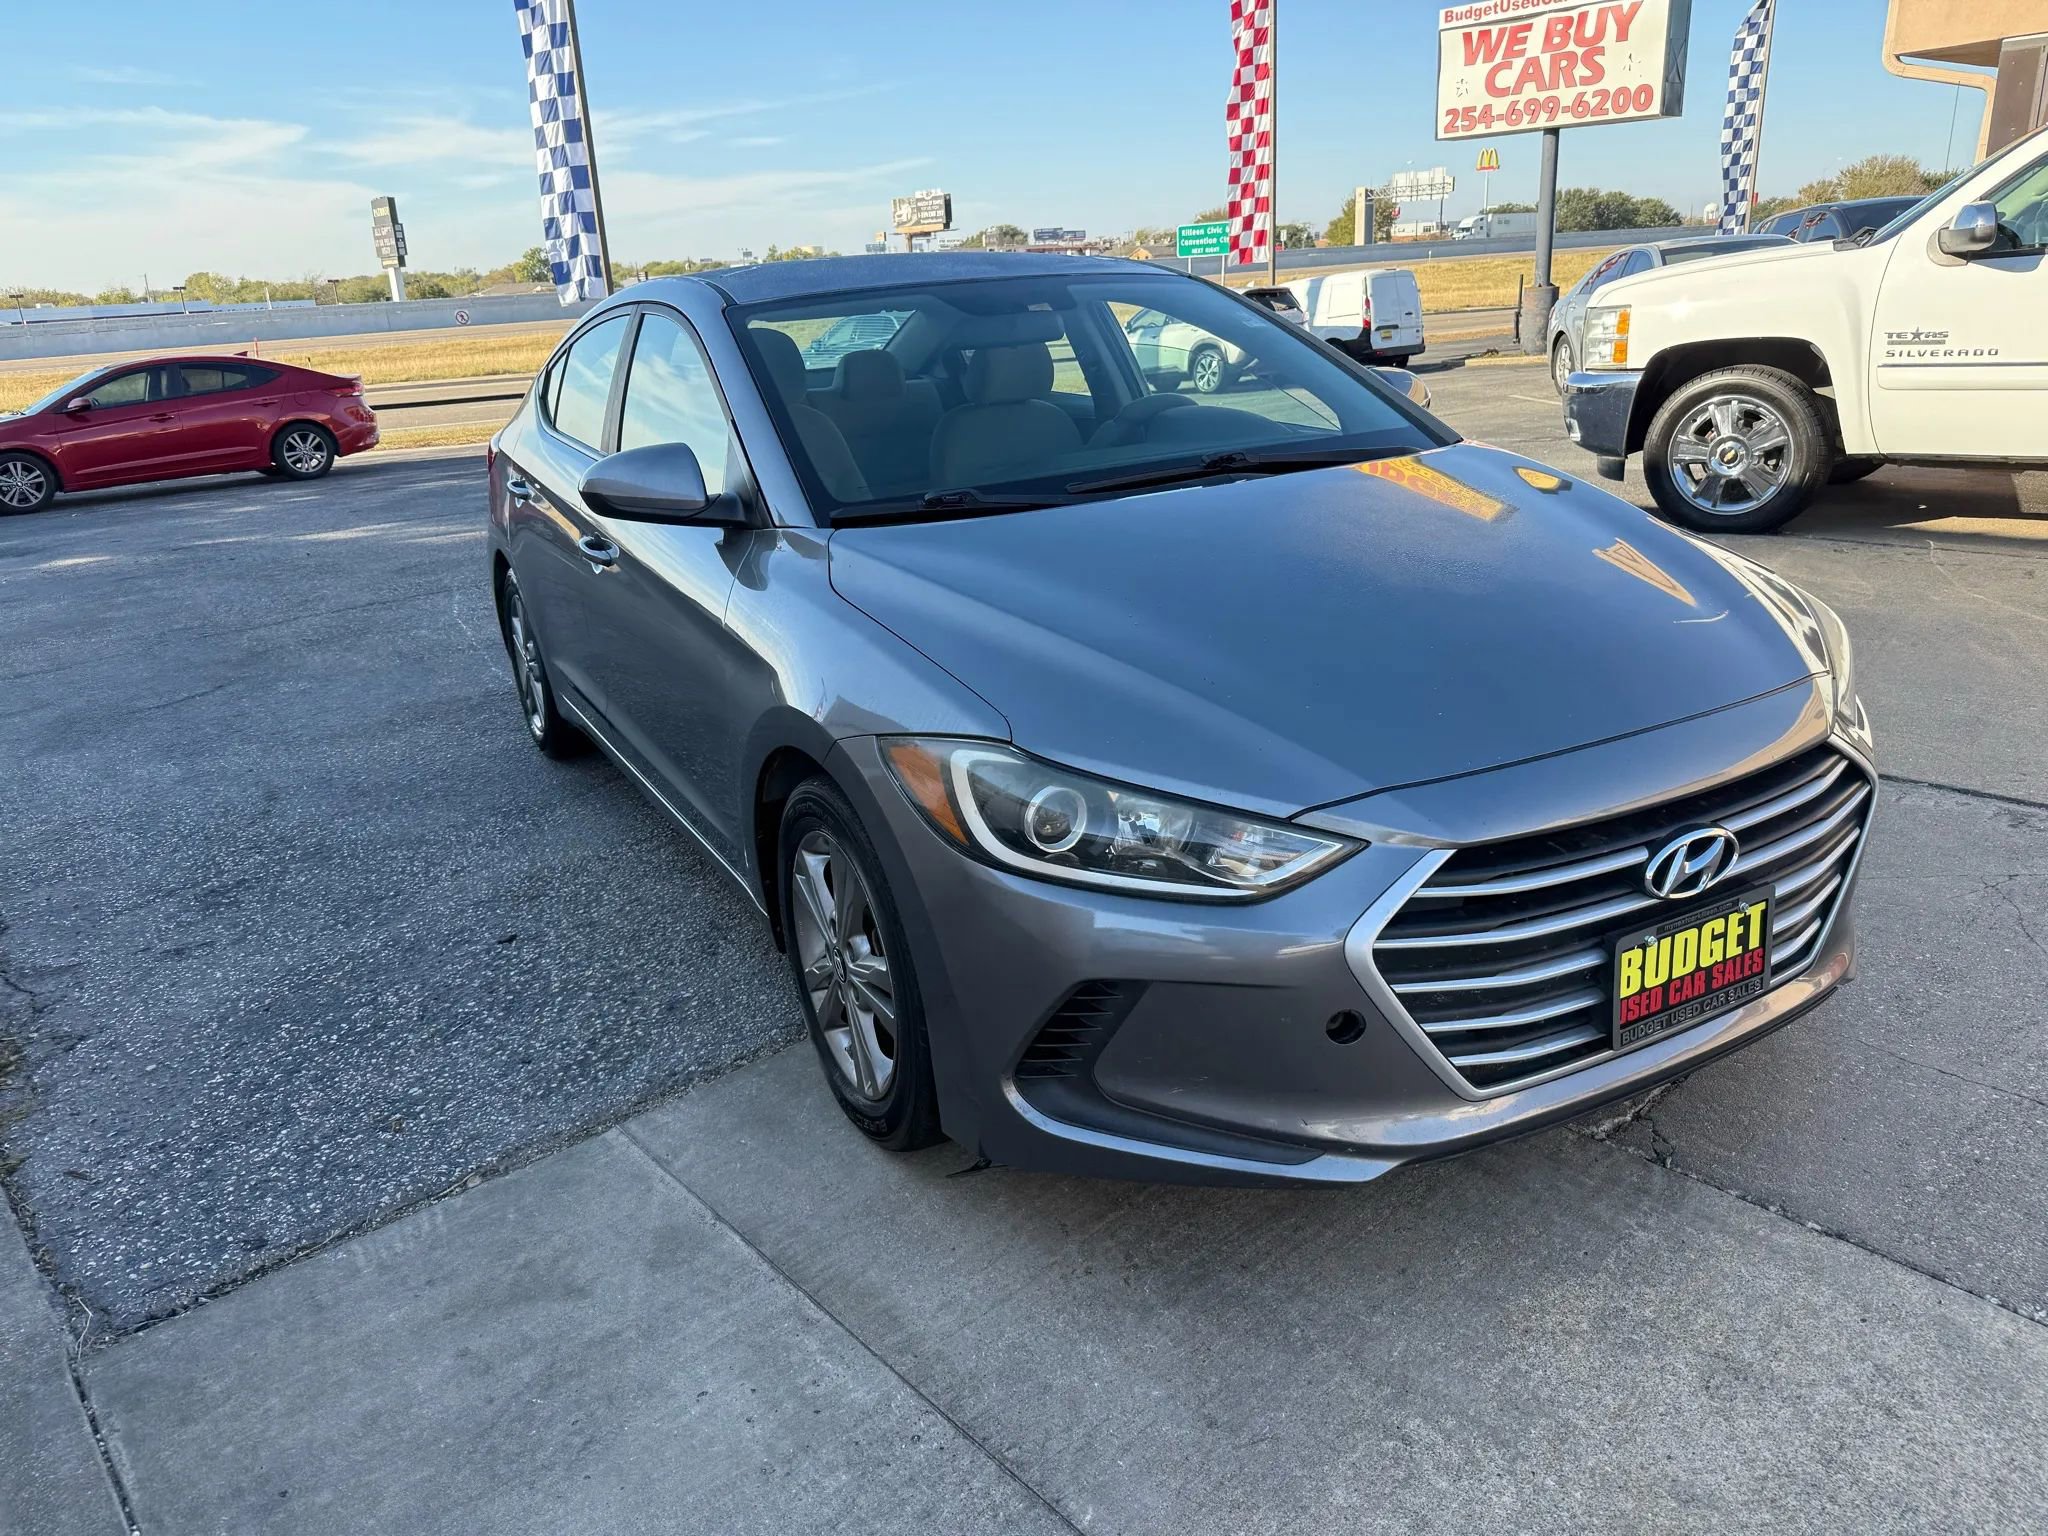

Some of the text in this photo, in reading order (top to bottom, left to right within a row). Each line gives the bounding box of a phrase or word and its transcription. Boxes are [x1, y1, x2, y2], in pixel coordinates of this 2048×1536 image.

[1444, 0, 1567, 24] BudgetUsed
[1462, 0, 1644, 66] WE BUY
[1485, 46, 1606, 98] CARS
[1443, 84, 1654, 134] 254-699-6200
[1181, 236, 1217, 246] Convention
[1182, 227, 1205, 236] Killeen
[1207, 226, 1223, 235] Civic
[1885, 348, 1999, 358] SILVERADO
[1619, 901, 1767, 999] BUDGET
[1668, 970, 1706, 1006] CAR
[1711, 947, 1764, 990] SALES
[1622, 978, 1761, 1046] BUDGET USED CAR SALES
